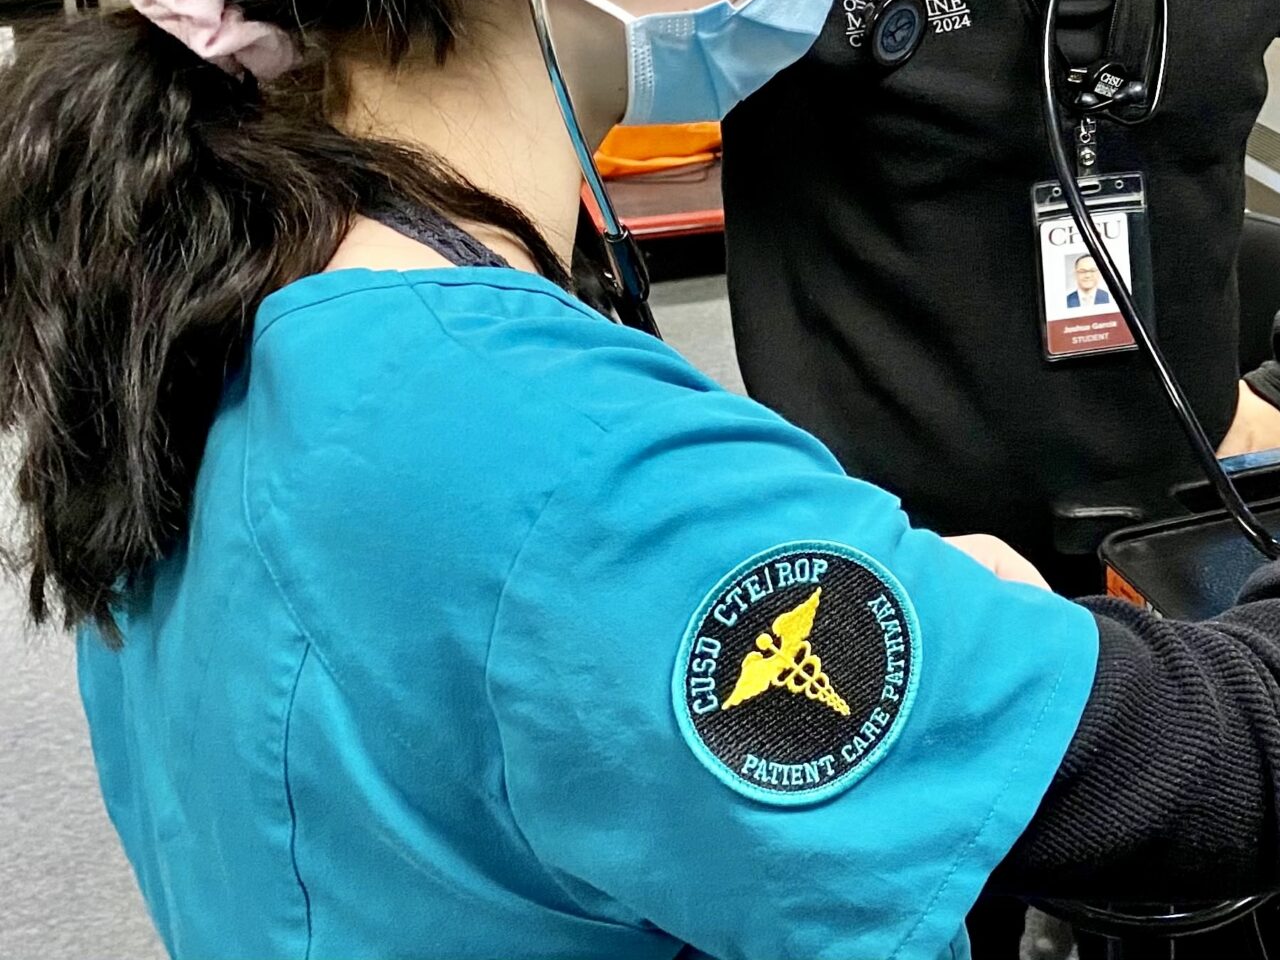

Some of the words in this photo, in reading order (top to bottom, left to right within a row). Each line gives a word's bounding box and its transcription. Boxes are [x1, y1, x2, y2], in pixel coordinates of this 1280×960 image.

[933, 14, 972, 34] 2024
[1048, 220, 1121, 247] CHU
[1071, 332, 1110, 345] STUDENT
[690, 636, 722, 715] CUSD
[741, 753, 835, 786] PATIENT
[841, 707, 890, 763] CARE
[868, 594, 906, 702] PATHWAY
